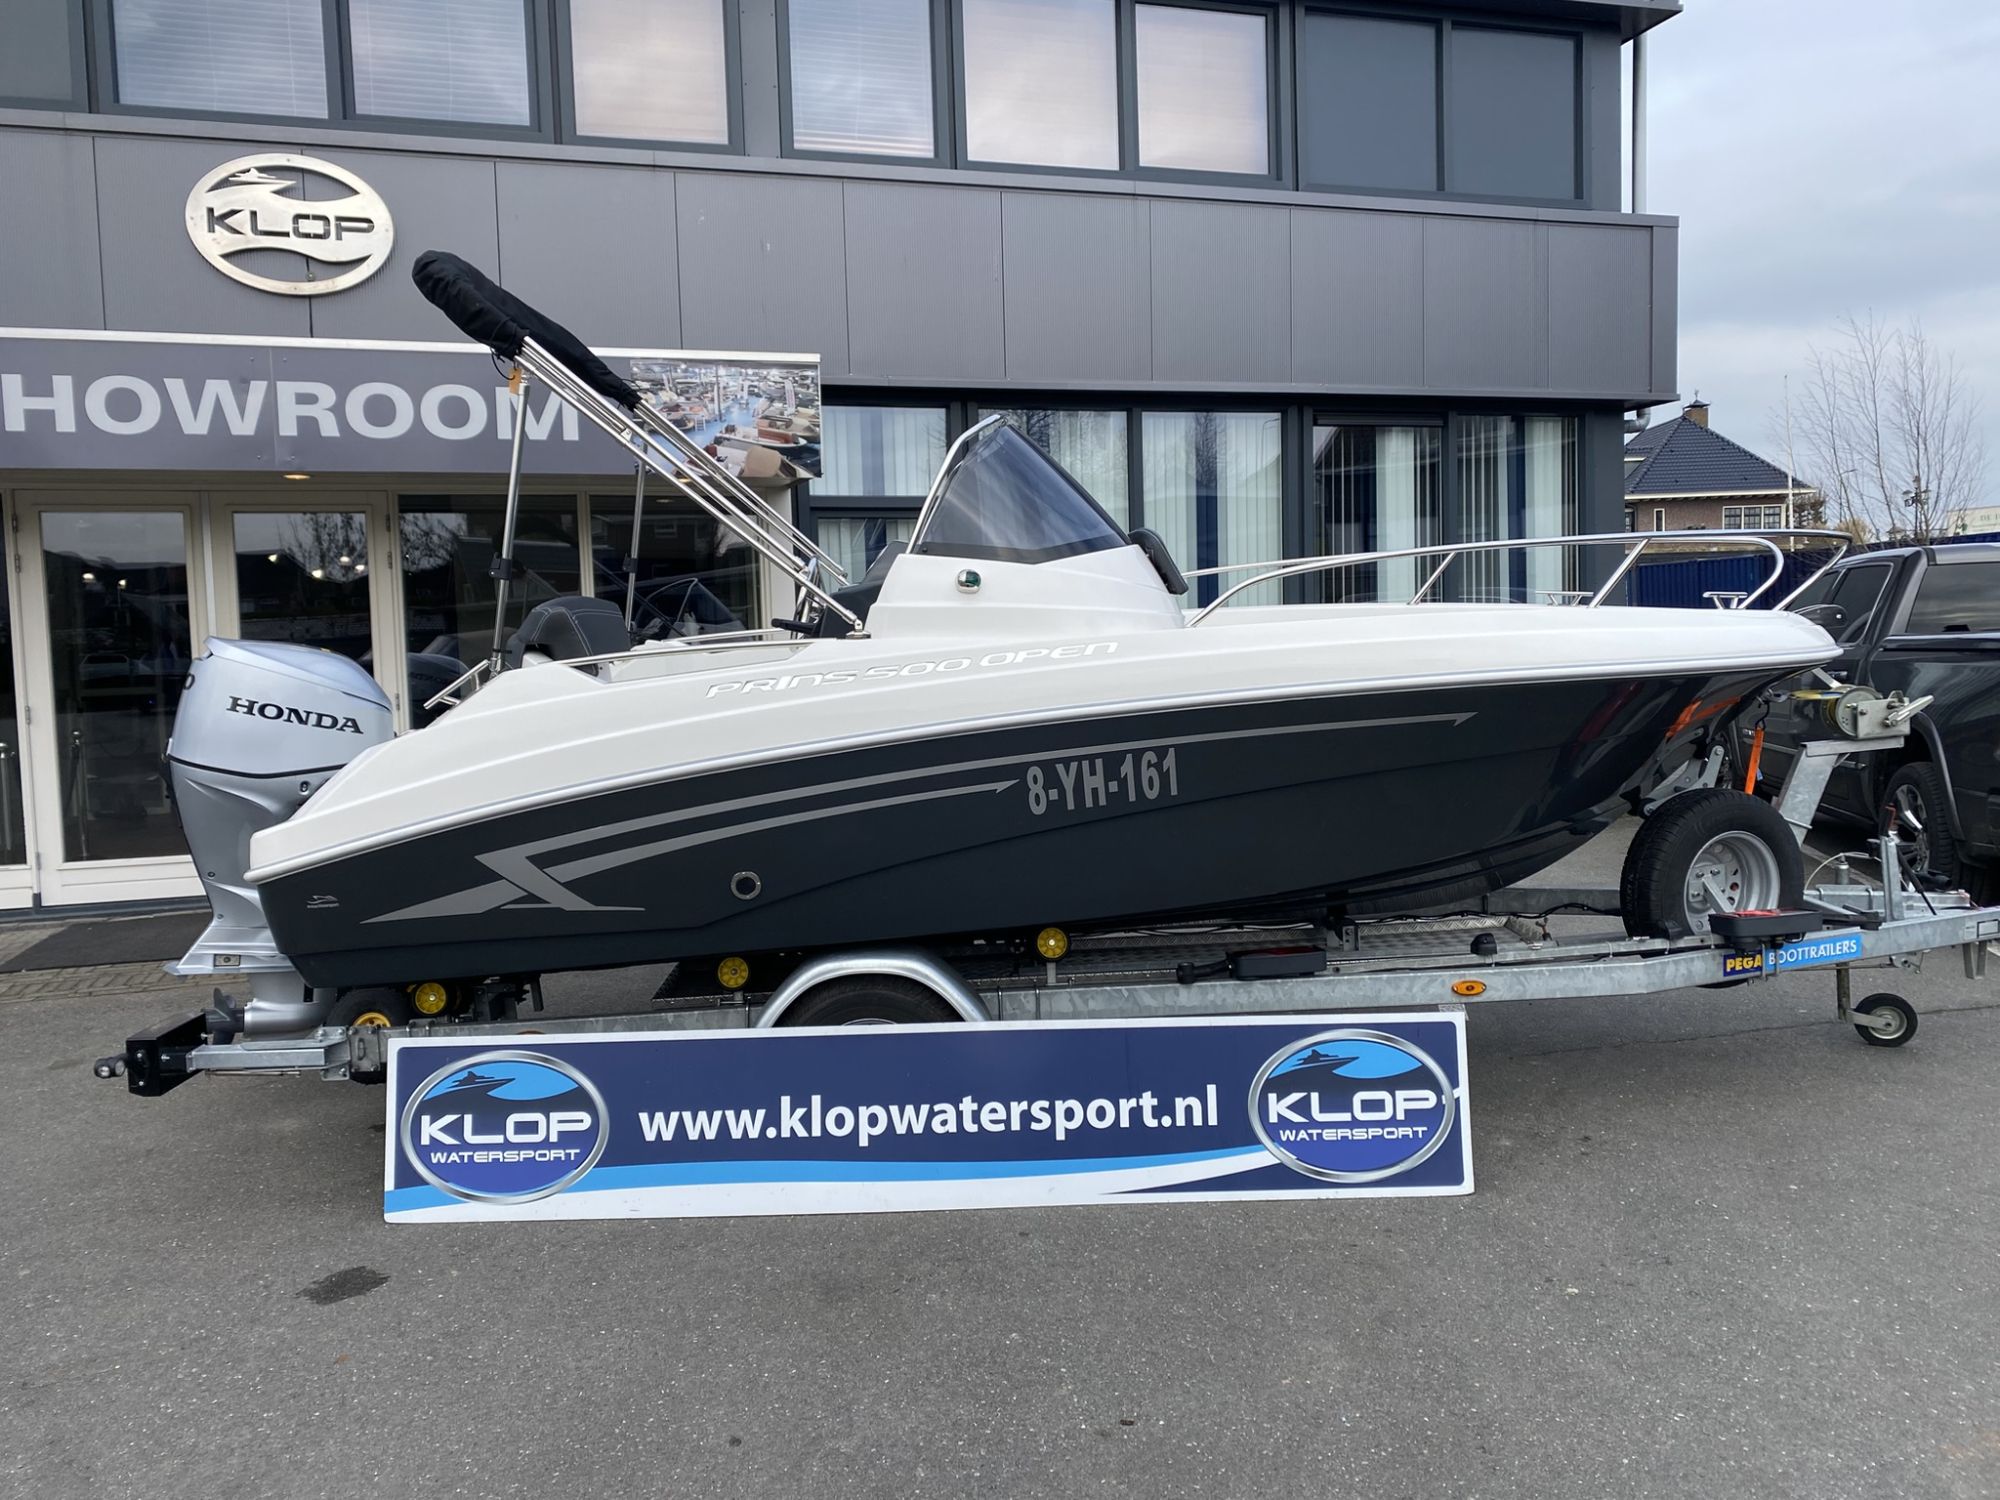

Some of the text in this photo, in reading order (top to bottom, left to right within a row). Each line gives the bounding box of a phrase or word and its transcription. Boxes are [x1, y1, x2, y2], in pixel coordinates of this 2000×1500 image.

[206, 207, 375, 241] KLOP
[865, 657, 971, 679] 500
[226, 696, 364, 734] HONDA
[1026, 747, 1178, 816] 8-YH-161
[1726, 940, 1857, 972] PEGA BOOTTRAILERS
[638, 1083, 1219, 1147] www.klopwatersport.nl
[1267, 1089, 1437, 1124] KLOP
[420, 1110, 592, 1145] KLOP
[1279, 1126, 1428, 1142] WATERSPORT
[430, 1149, 581, 1164] WATERSPORT
